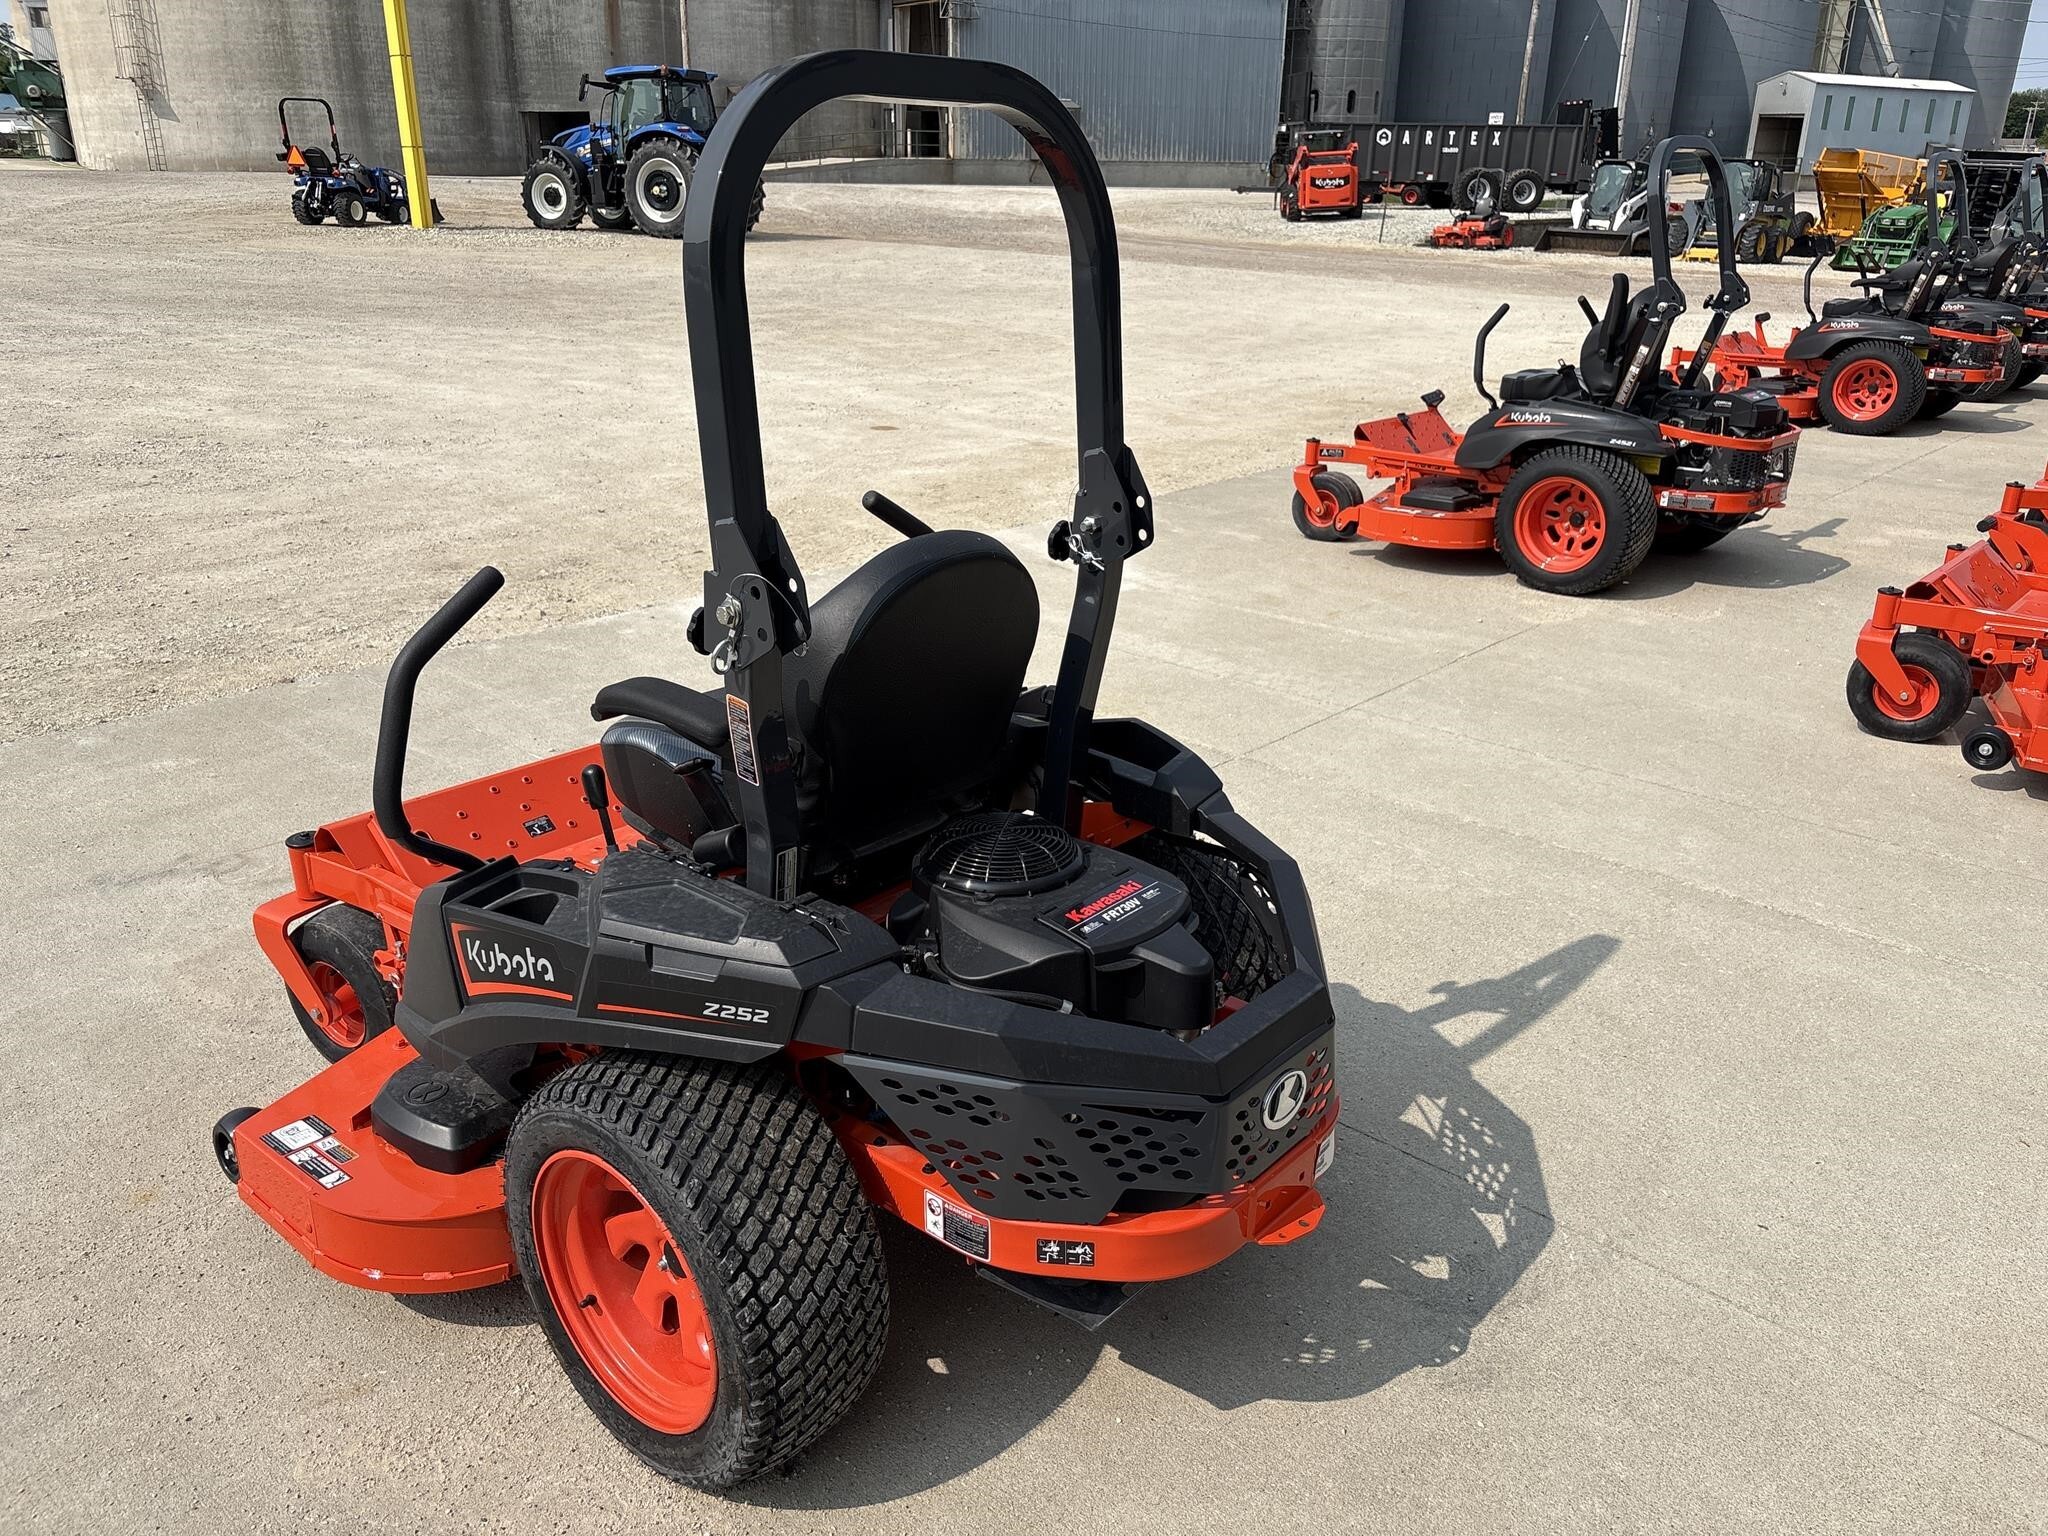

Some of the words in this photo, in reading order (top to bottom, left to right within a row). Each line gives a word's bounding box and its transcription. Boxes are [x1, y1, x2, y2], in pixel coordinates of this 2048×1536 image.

[1402, 130, 1501, 146] ARTEX
[1315, 178, 1345, 187] Kubota
[1830, 320, 1859, 329] Kubota
[1510, 412, 1552, 423] Kubota
[1065, 880, 1143, 922] Kawasaki
[1101, 897, 1141, 921] FR730V
[466, 938, 555, 982] Kubota
[702, 1002, 770, 1023] Z252
